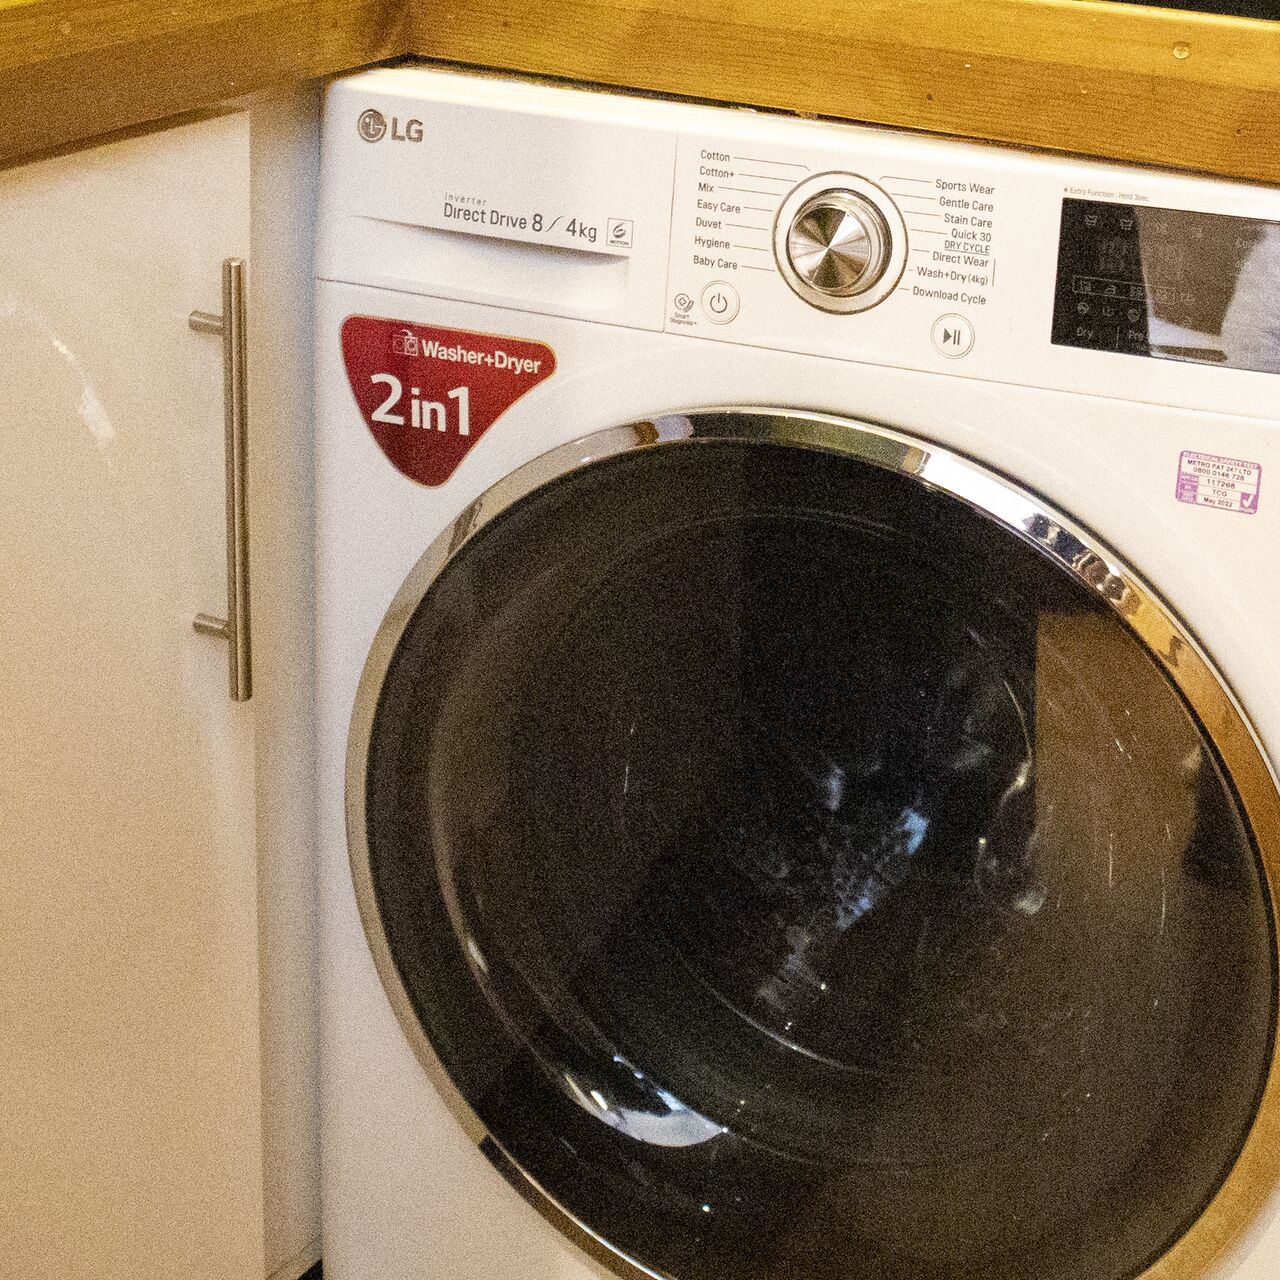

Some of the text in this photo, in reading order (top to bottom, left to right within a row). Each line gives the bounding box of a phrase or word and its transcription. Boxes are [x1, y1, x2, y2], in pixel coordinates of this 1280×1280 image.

[391, 117, 423, 143] LG
[700, 149, 730, 162] Cotton
[699, 166, 735, 178] Cotton+
[698, 182, 714, 193] Mix
[935, 179, 995, 195] Sports Wear
[1069, 186, 1086, 195] Extra
[1087, 188, 1115, 198] Function
[1118, 192, 1133, 200] Hold
[697, 199, 740, 214] Easy Care
[939, 196, 994, 212] Gentle Care
[444, 203, 486, 225] Direct
[489, 210, 527, 230] Drive
[532, 213, 543, 232] 8
[566, 218, 598, 242] 4kg
[695, 217, 722, 229] Duvet
[944, 213, 993, 228] Stain Care
[951, 228, 991, 242] Quick 30
[694, 236, 730, 250] Hygiene
[944, 240, 990, 254] DRY CYCLE
[693, 255, 737, 270] Baby Care
[932, 251, 989, 268] Direct Wear
[913, 286, 986, 305] Download Cycle
[1076, 326, 1094, 340] Dry
[421, 338, 542, 375] Washer+Dryer
[1187, 459, 1210, 468] METRO
[1239, 468, 1252, 476] LTD
[1212, 470, 1230, 478] 0146
[1232, 473, 1244, 481] 728
[1213, 489, 1227, 497] TCG
[1203, 497, 1216, 505] May
